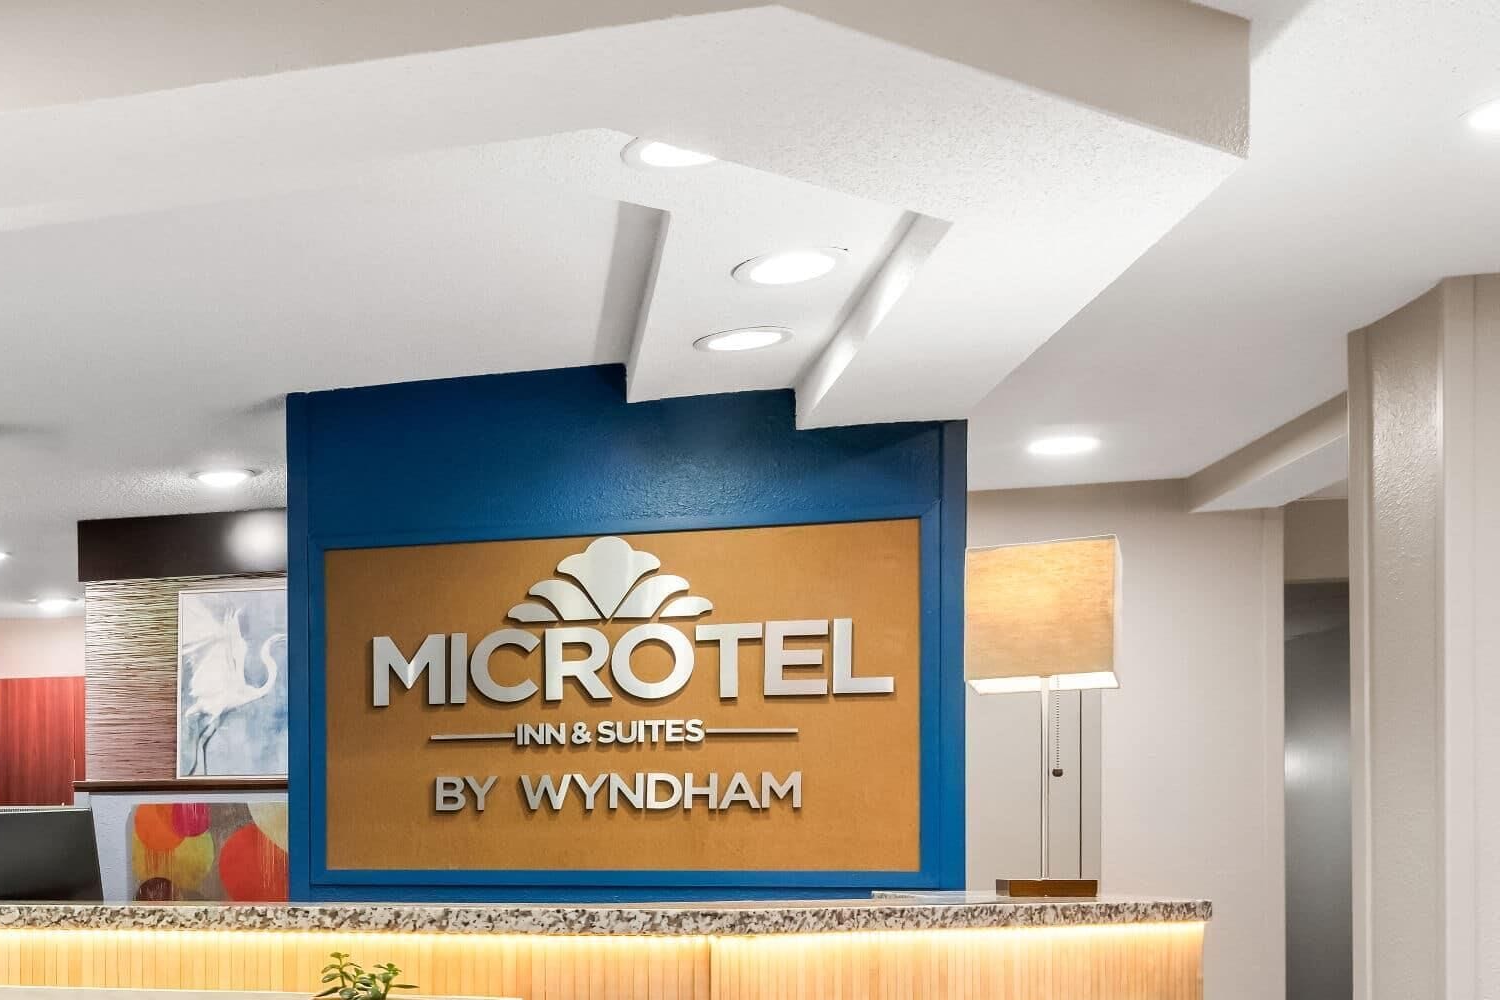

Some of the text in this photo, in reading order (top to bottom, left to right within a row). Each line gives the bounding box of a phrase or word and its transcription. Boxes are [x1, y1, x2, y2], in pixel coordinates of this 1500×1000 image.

[372, 618, 894, 707] MICROTEL
[516, 719, 705, 745] INN & SUITES
[435, 771, 802, 811] BY WYNDHAM
